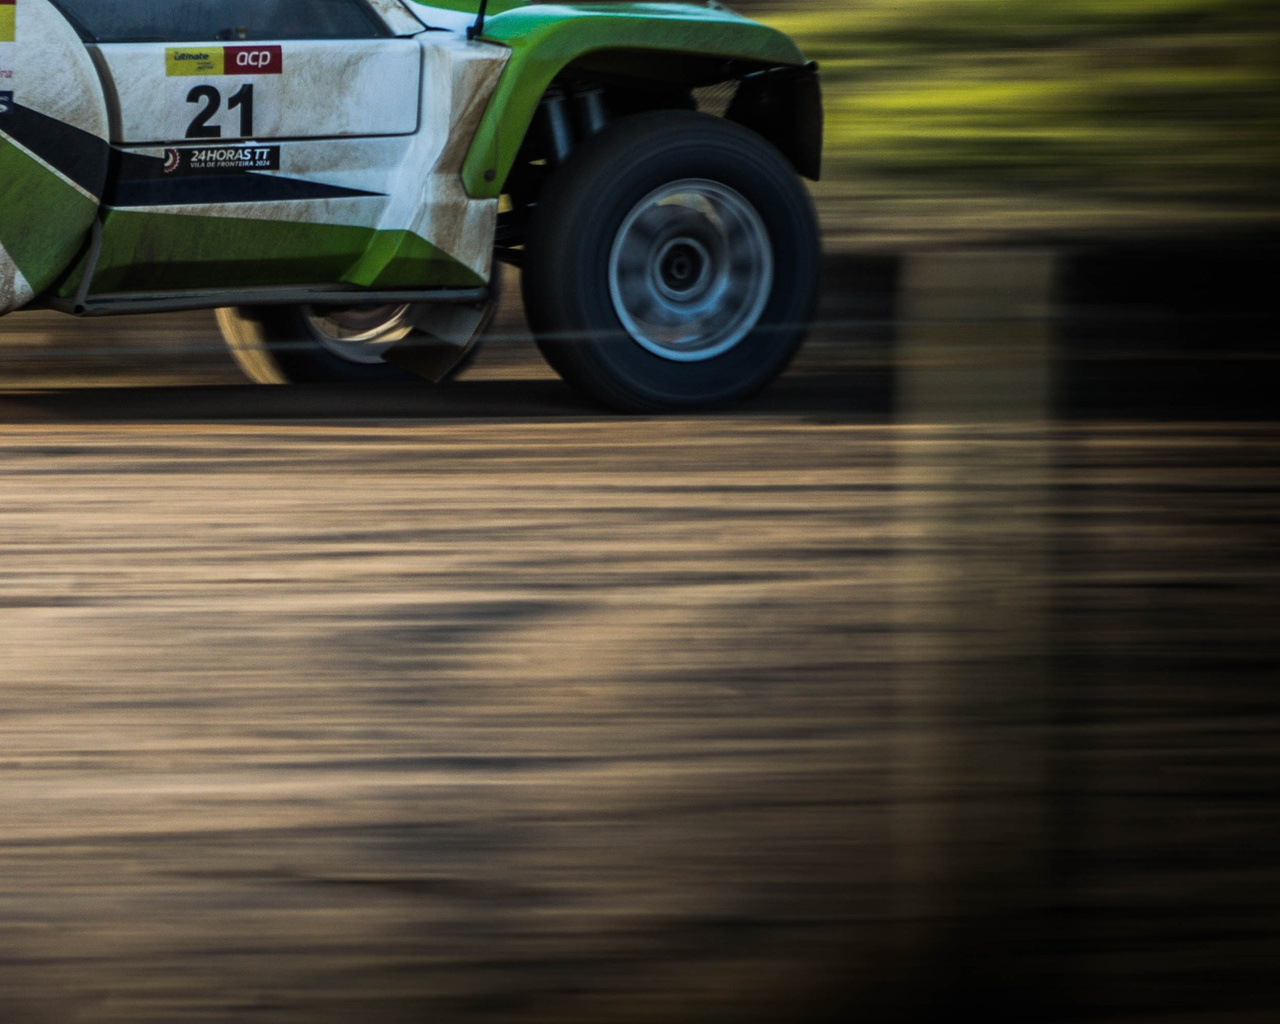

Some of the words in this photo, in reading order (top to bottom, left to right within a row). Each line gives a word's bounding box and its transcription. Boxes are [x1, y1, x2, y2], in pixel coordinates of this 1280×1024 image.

[236, 51, 271, 68] acp
[185, 83, 253, 138] 21
[254, 148, 270, 160] TT
